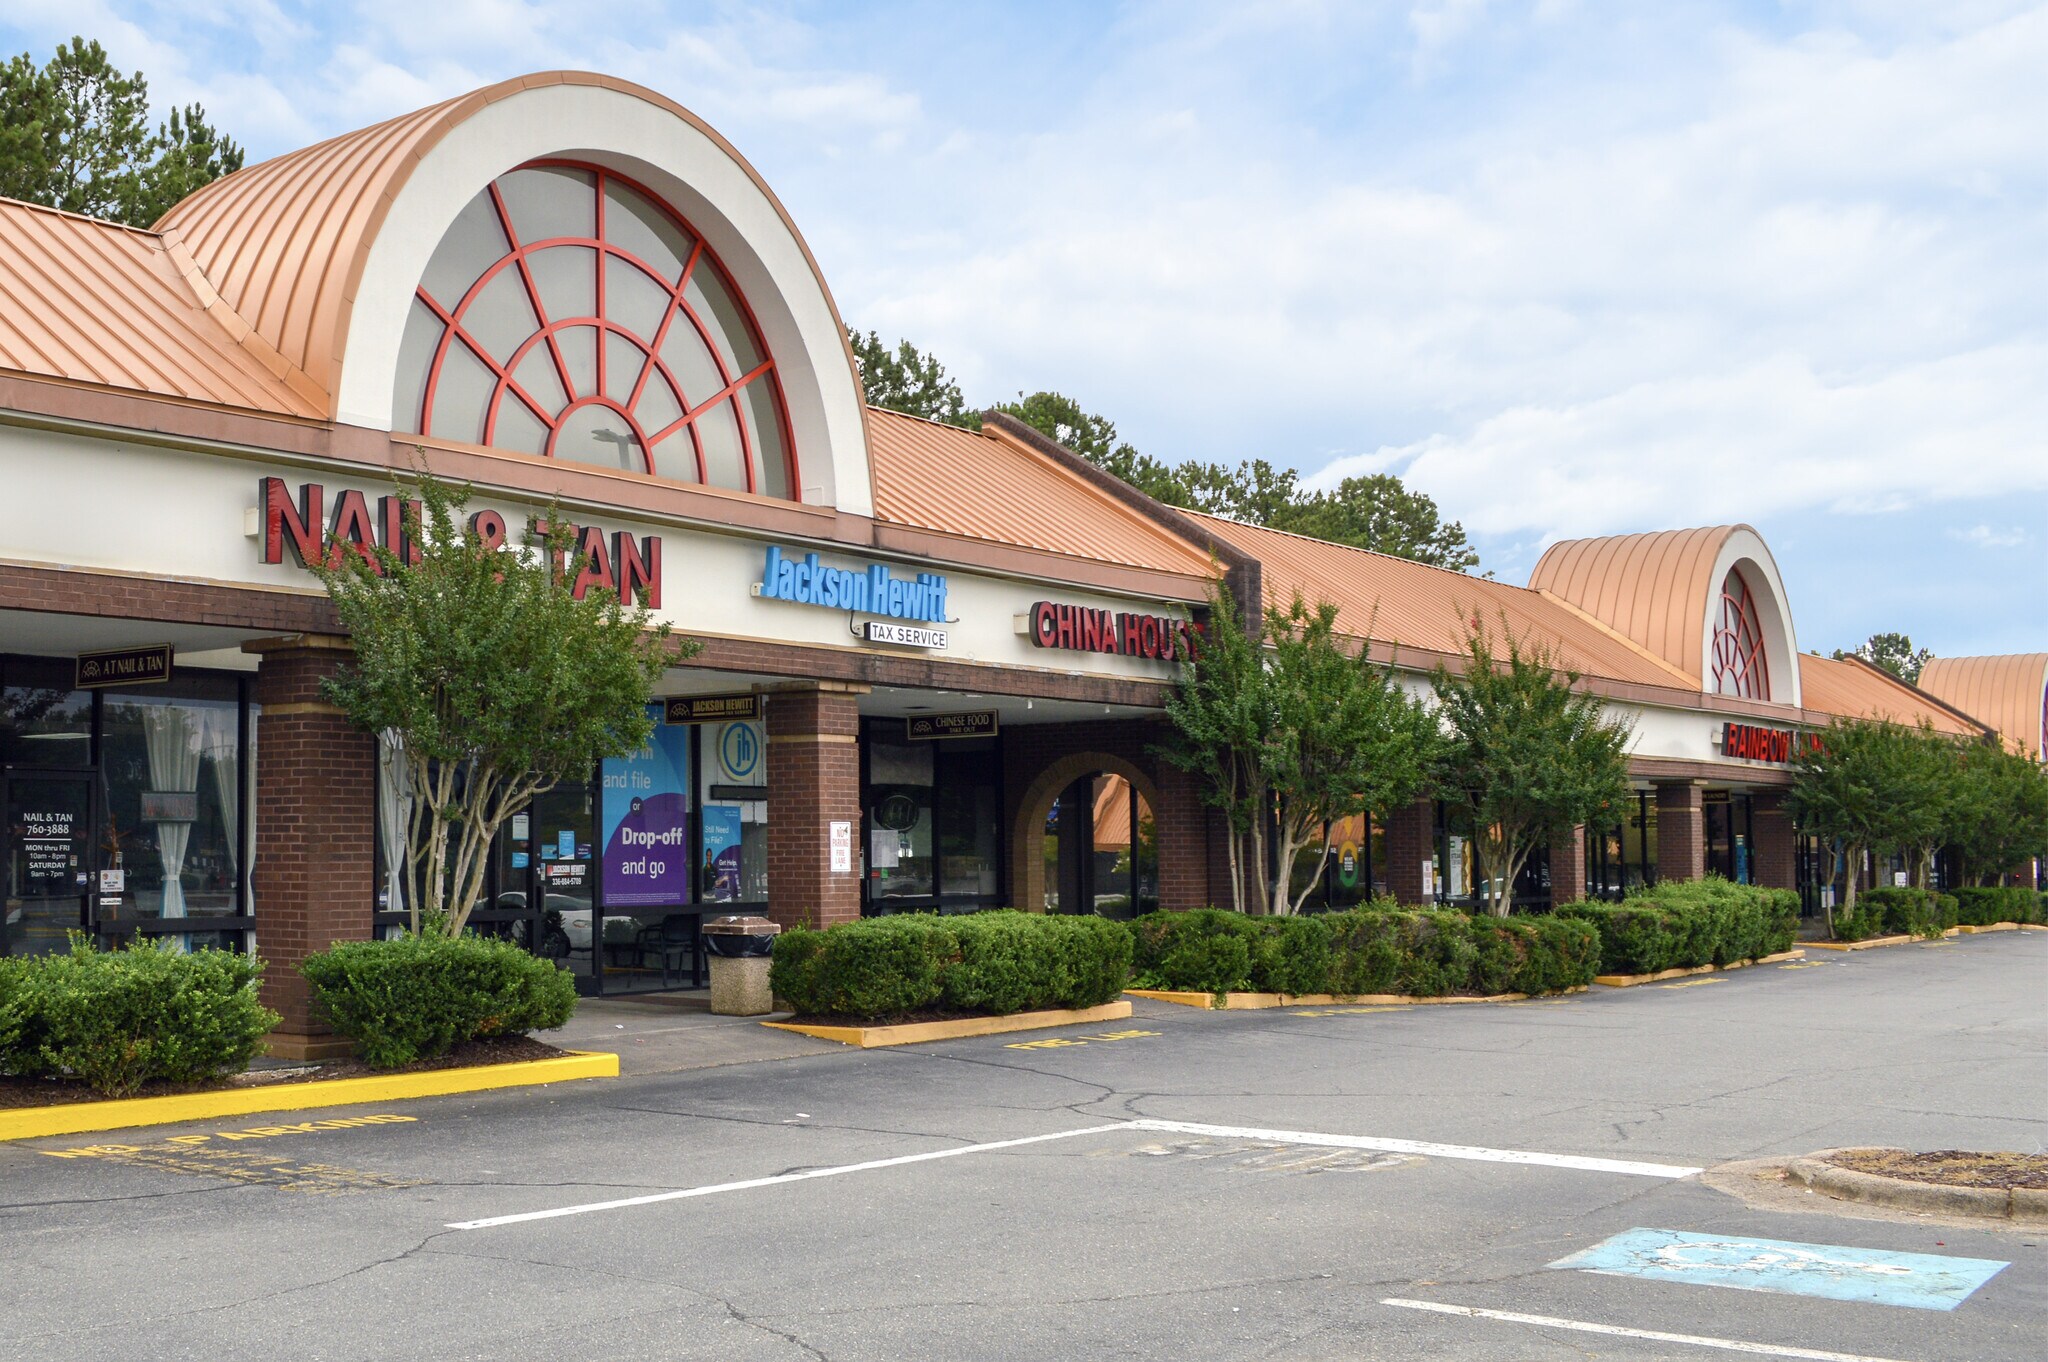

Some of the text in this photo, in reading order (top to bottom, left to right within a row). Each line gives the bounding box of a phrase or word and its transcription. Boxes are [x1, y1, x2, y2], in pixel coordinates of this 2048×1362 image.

[535, 519, 662, 610] TAN
[762, 546, 947, 623] Jackson Hewitt
[872, 624, 946, 647] TAX SERVICE
[1029, 601, 1118, 654] CHINA
[103, 656, 164, 675] A T NAIL & TAN
[693, 697, 754, 712] JACKSON HEWITT
[935, 714, 989, 728] CHINESE FOOD
[1721, 722, 1790, 763] RAINBOW
[603, 770, 651, 789] and file
[23, 813, 73, 822] NAIL & TAN
[633, 802, 640, 811] or
[27, 824, 69, 836] 760-3888
[622, 827, 683, 849] Drop-off
[622, 856, 666, 879] and go
[37, 1114, 419, 1159] NO PARKING
